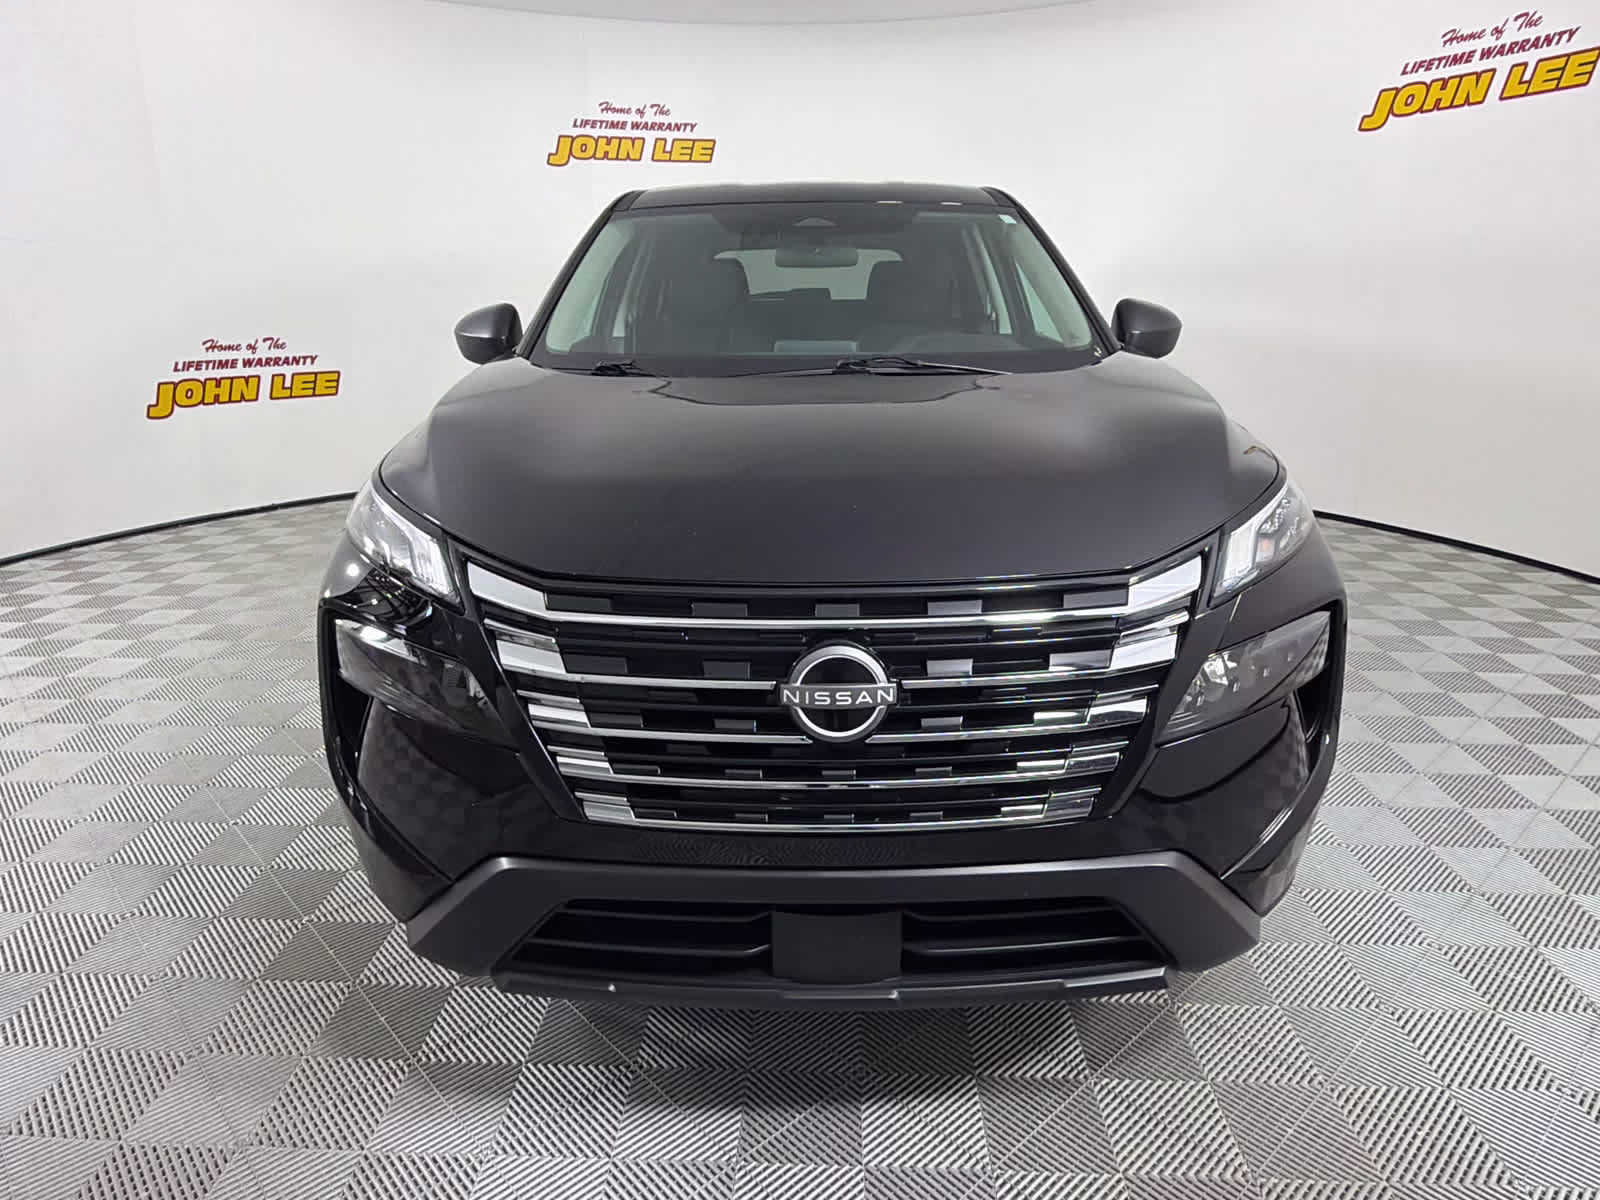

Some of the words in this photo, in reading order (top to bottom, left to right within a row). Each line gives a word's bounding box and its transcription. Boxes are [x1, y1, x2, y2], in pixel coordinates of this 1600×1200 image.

[1441, 28, 1487, 48] Home
[1490, 18, 1508, 41] of
[1513, 10, 1543, 29] The
[1400, 50, 1477, 76] LIFETIME
[1479, 26, 1581, 62] WARRANTY
[1358, 68, 1496, 131] JOHN
[1499, 46, 1600, 101] LEE
[598, 101, 632, 116] Home
[635, 104, 647, 120] of
[649, 103, 671, 117] The
[573, 118, 627, 130] LIFETIME
[630, 120, 697, 133] WARRANTY
[547, 134, 646, 167] JOHN
[651, 137, 716, 163] LEE
[201, 338, 242, 353] Home
[245, 338, 259, 354] of
[262, 337, 287, 350] The
[173, 358, 238, 372] LIFETIME
[242, 355, 318, 369] WARRANTY
[146, 374, 260, 420] JOHN
[270, 371, 340, 400] LEE
[783, 687, 894, 705] NISSAN
